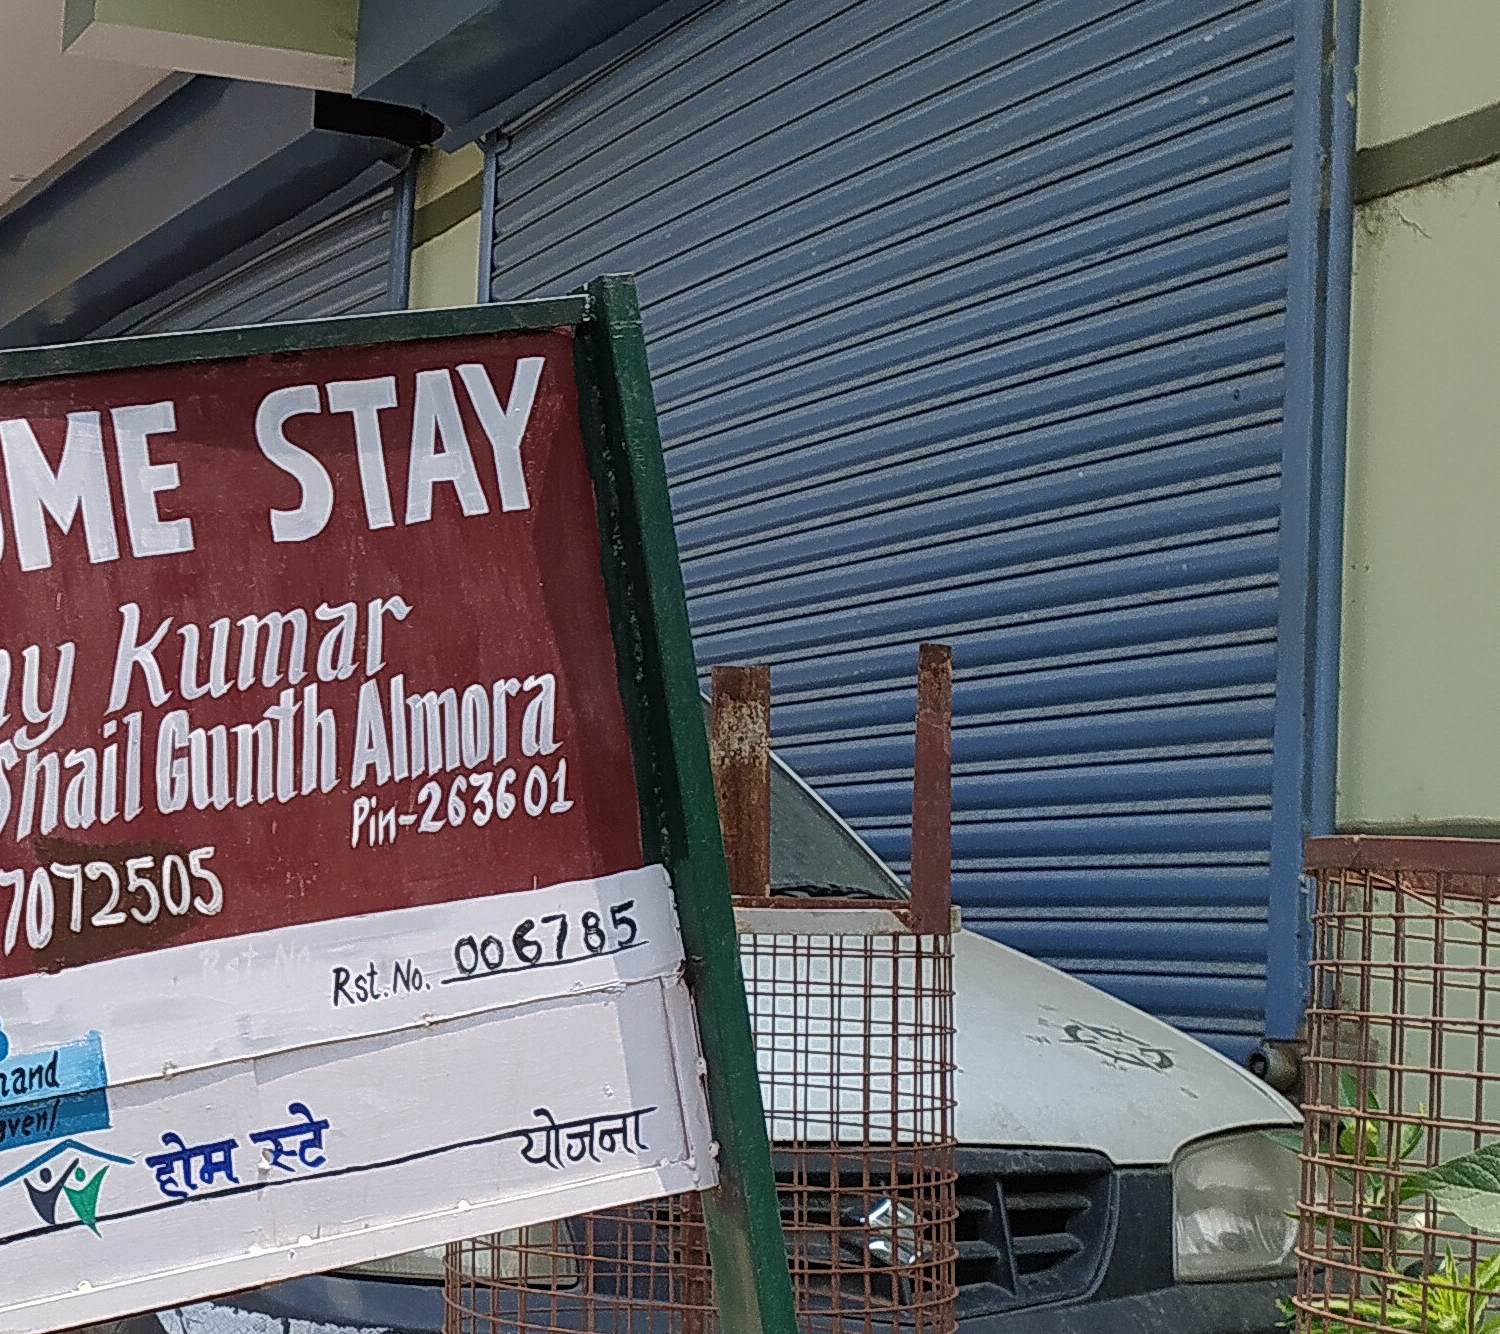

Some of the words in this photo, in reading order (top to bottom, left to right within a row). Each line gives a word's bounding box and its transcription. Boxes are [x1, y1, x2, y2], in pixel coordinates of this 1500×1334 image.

[255, 356, 545, 543] STAY
[104, 595, 413, 715] Kumar
[156, 683, 342, 814] Gunth
[351, 673, 564, 790] Almora
[454, 900, 640, 975] 006785
[145, 1132, 240, 1198] होम
[249, 1102, 330, 1172] स्टे
[520, 1107, 658, 1169] योजना
